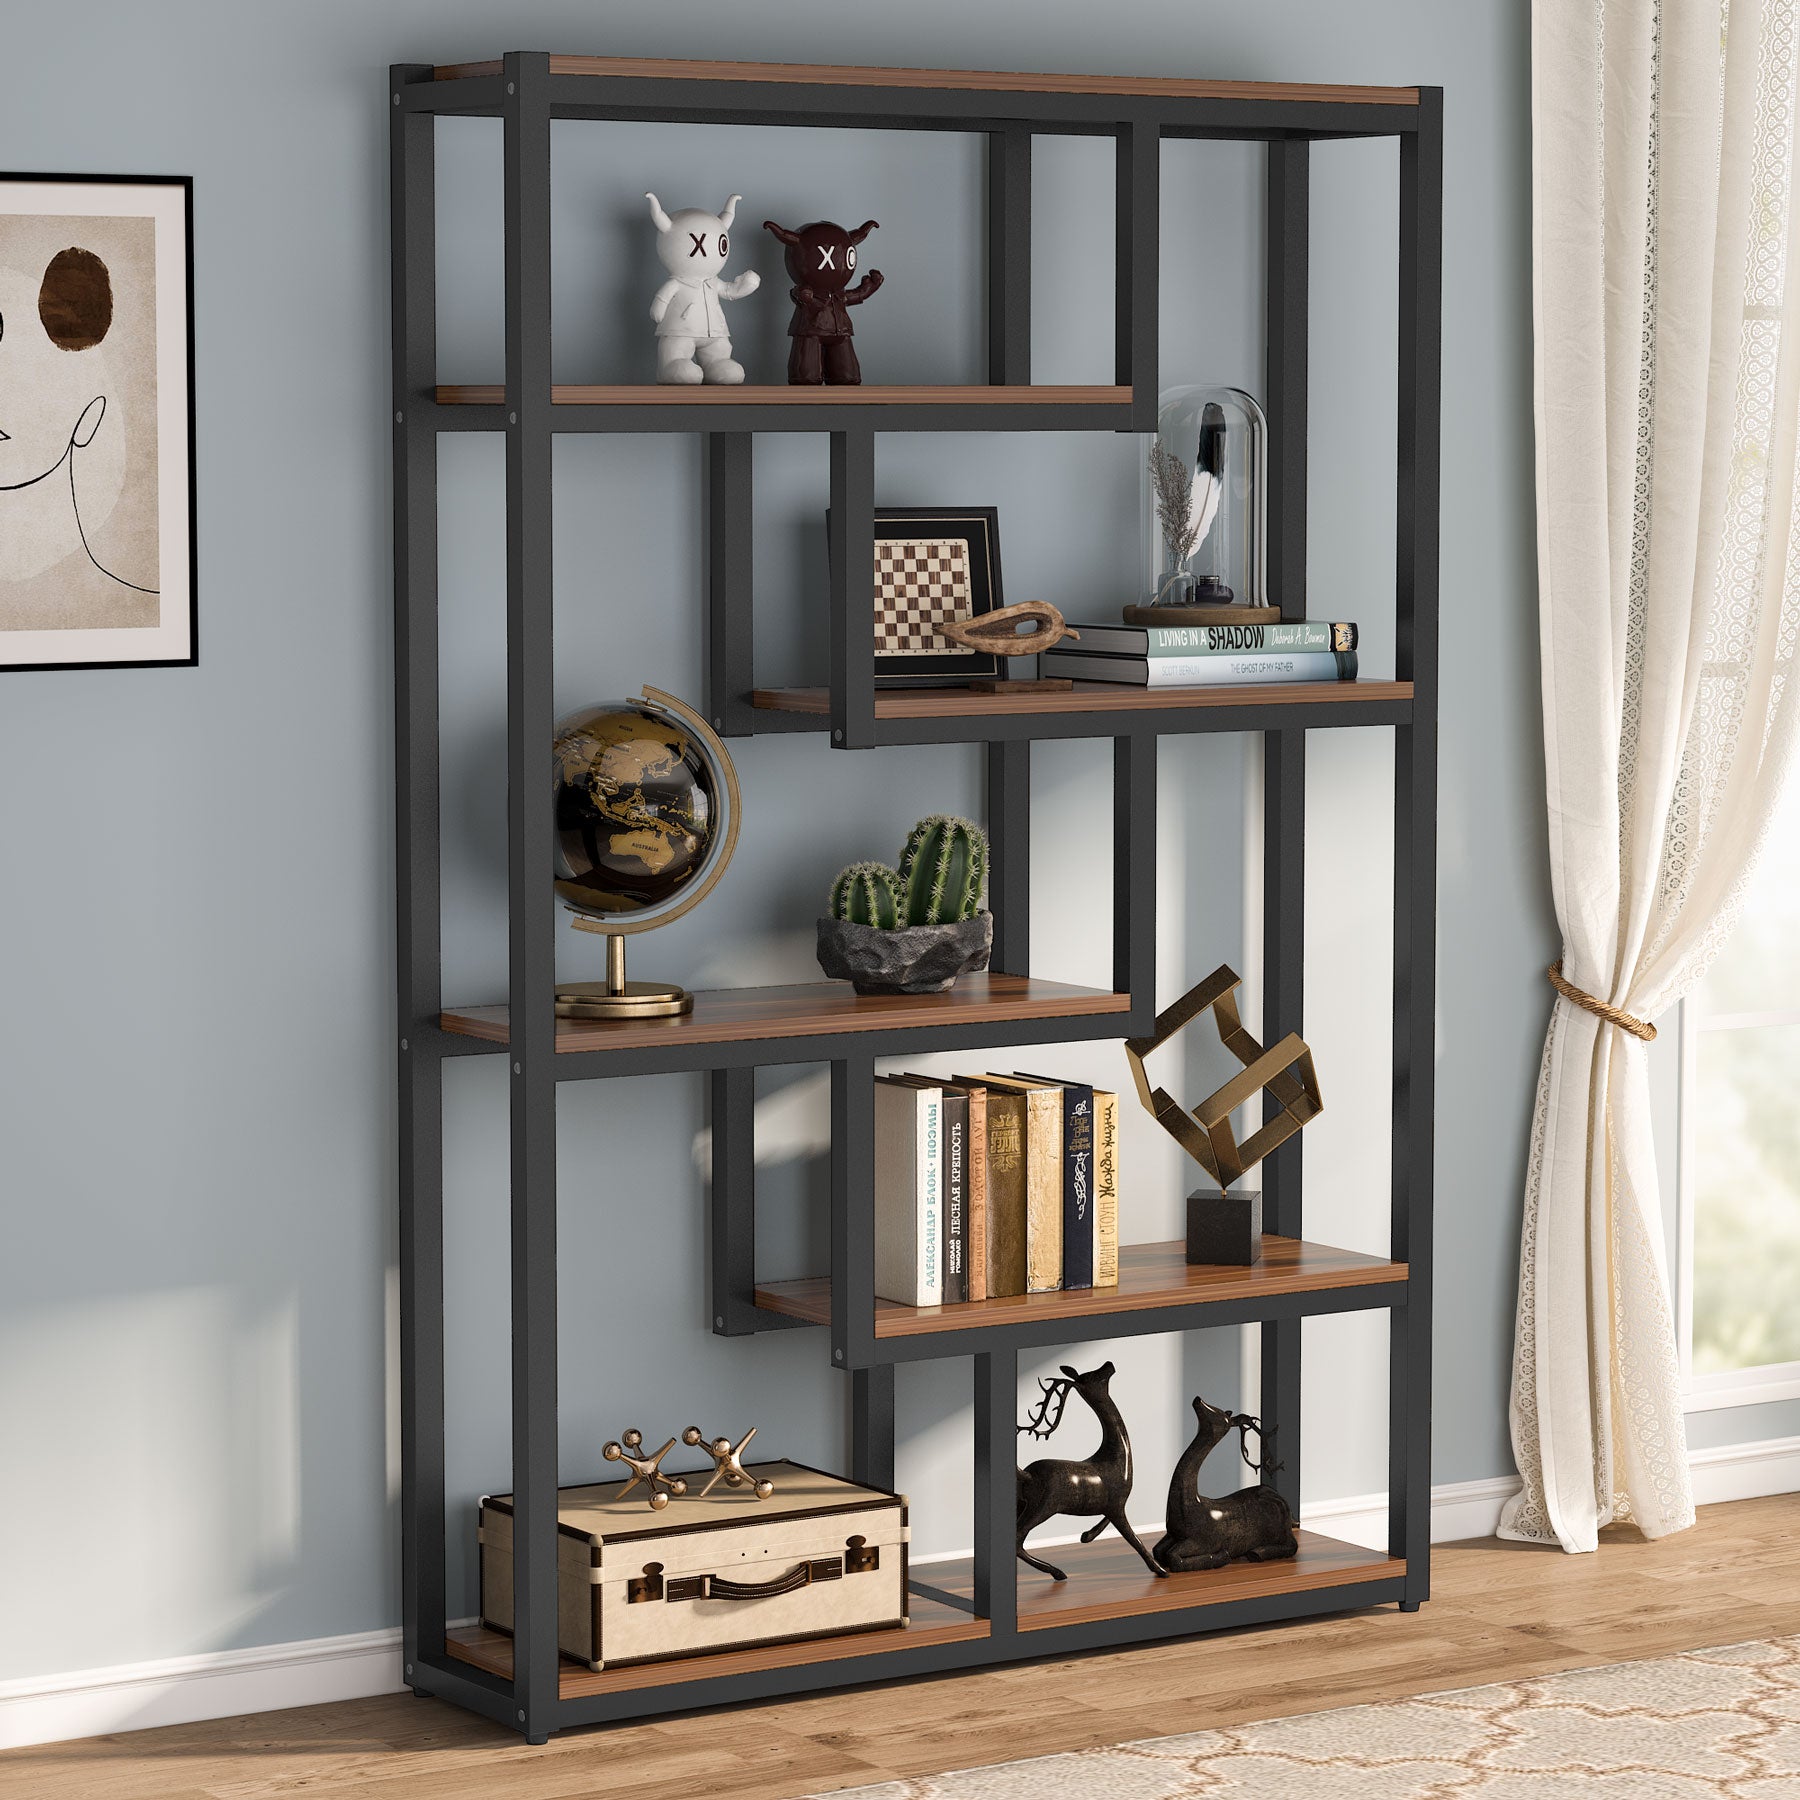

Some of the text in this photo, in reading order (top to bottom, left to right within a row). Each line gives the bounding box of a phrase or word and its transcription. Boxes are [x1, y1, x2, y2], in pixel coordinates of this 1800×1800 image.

[1158, 626, 1265, 650] LIVING IN A SHADOW
[1240, 662, 1258, 674] GHOST
[1258, 662, 1266, 673] OF
[1266, 662, 1275, 672] MY
[1274, 661, 1294, 672] FATHER
[631, 842, 659, 853] AUSTRALIA
[951, 1122, 962, 1235] ЛЕСНАЯ КРЕПОСТЬ
[1099, 1102, 1116, 1198] Жажда жизни
[925, 1103, 937, 1288] АЛЕКСАНДР БЛОК ПОЭМЫ
[1099, 1201, 1116, 1279] ИРВИНГ СТОУН
